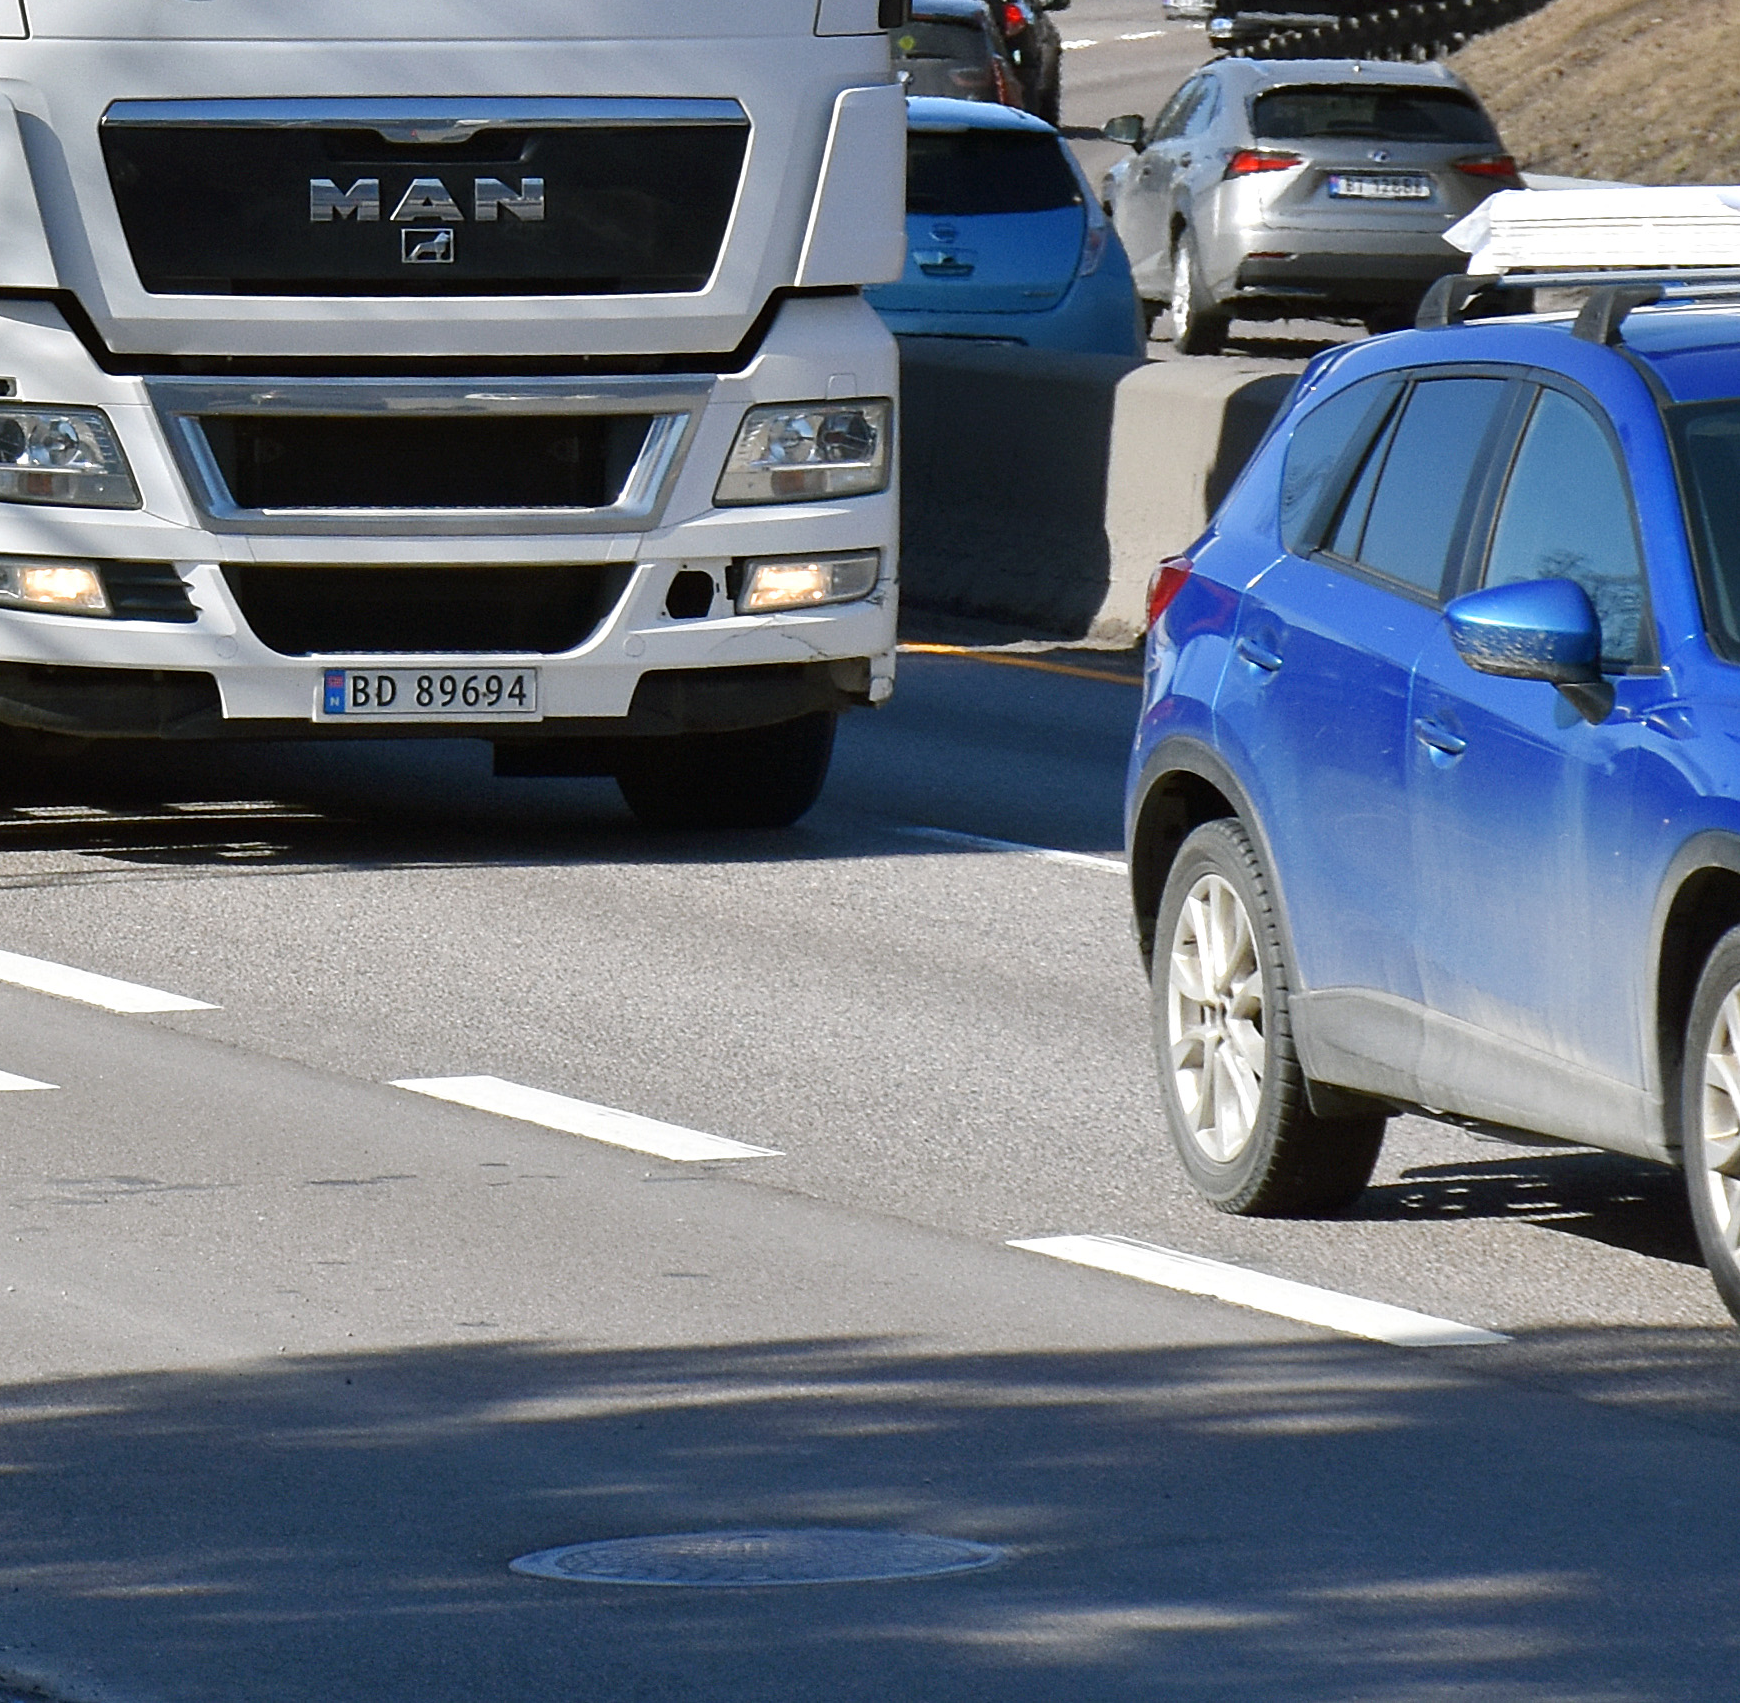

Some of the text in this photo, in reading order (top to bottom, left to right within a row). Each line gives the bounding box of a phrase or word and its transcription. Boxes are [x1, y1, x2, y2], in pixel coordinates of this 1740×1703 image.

[310, 178, 545, 221] MAN
[351, 674, 527, 707] BD 89694
